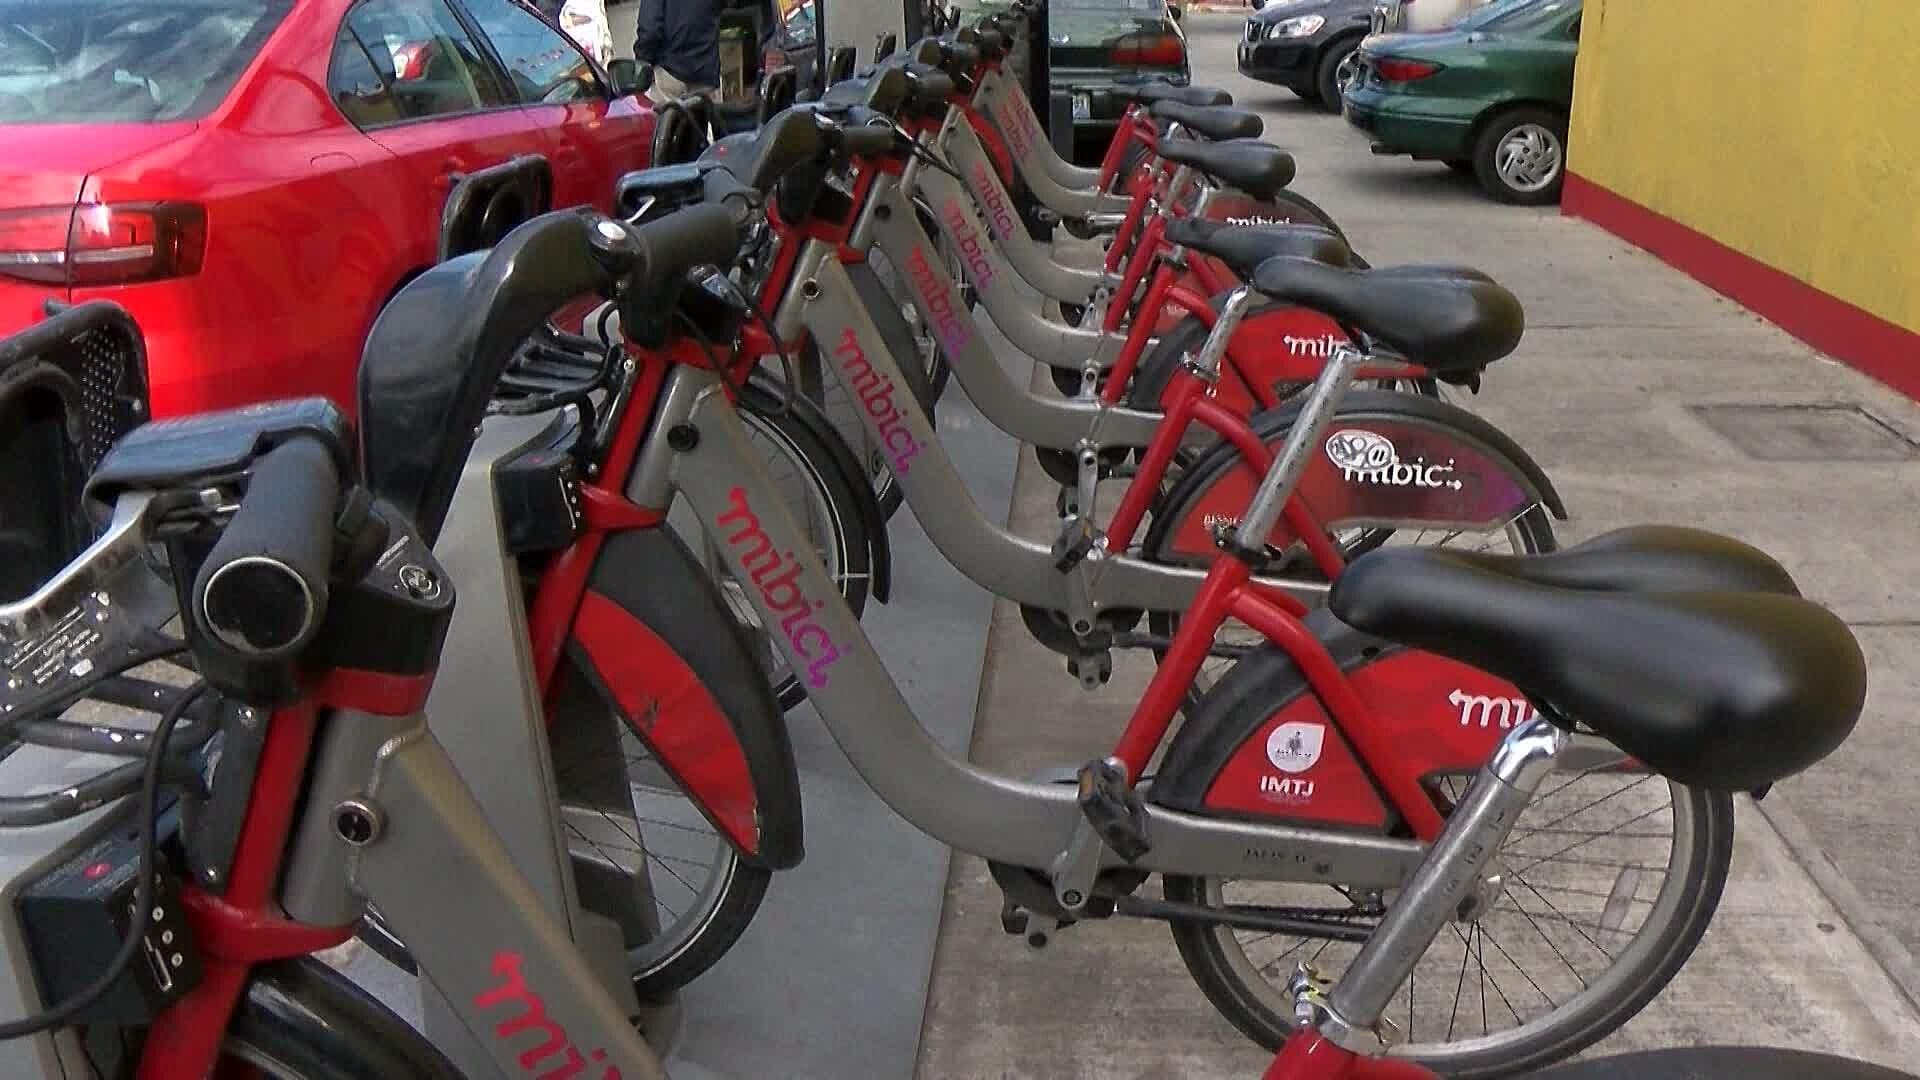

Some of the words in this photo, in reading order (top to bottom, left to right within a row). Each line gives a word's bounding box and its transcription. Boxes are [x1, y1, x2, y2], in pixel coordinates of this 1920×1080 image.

[834, 327, 928, 475] mibici
[716, 485, 852, 689] mibici
[1449, 688, 1540, 727] mi
[1260, 775, 1315, 796] IMTJ
[473, 949, 625, 1080] mi
